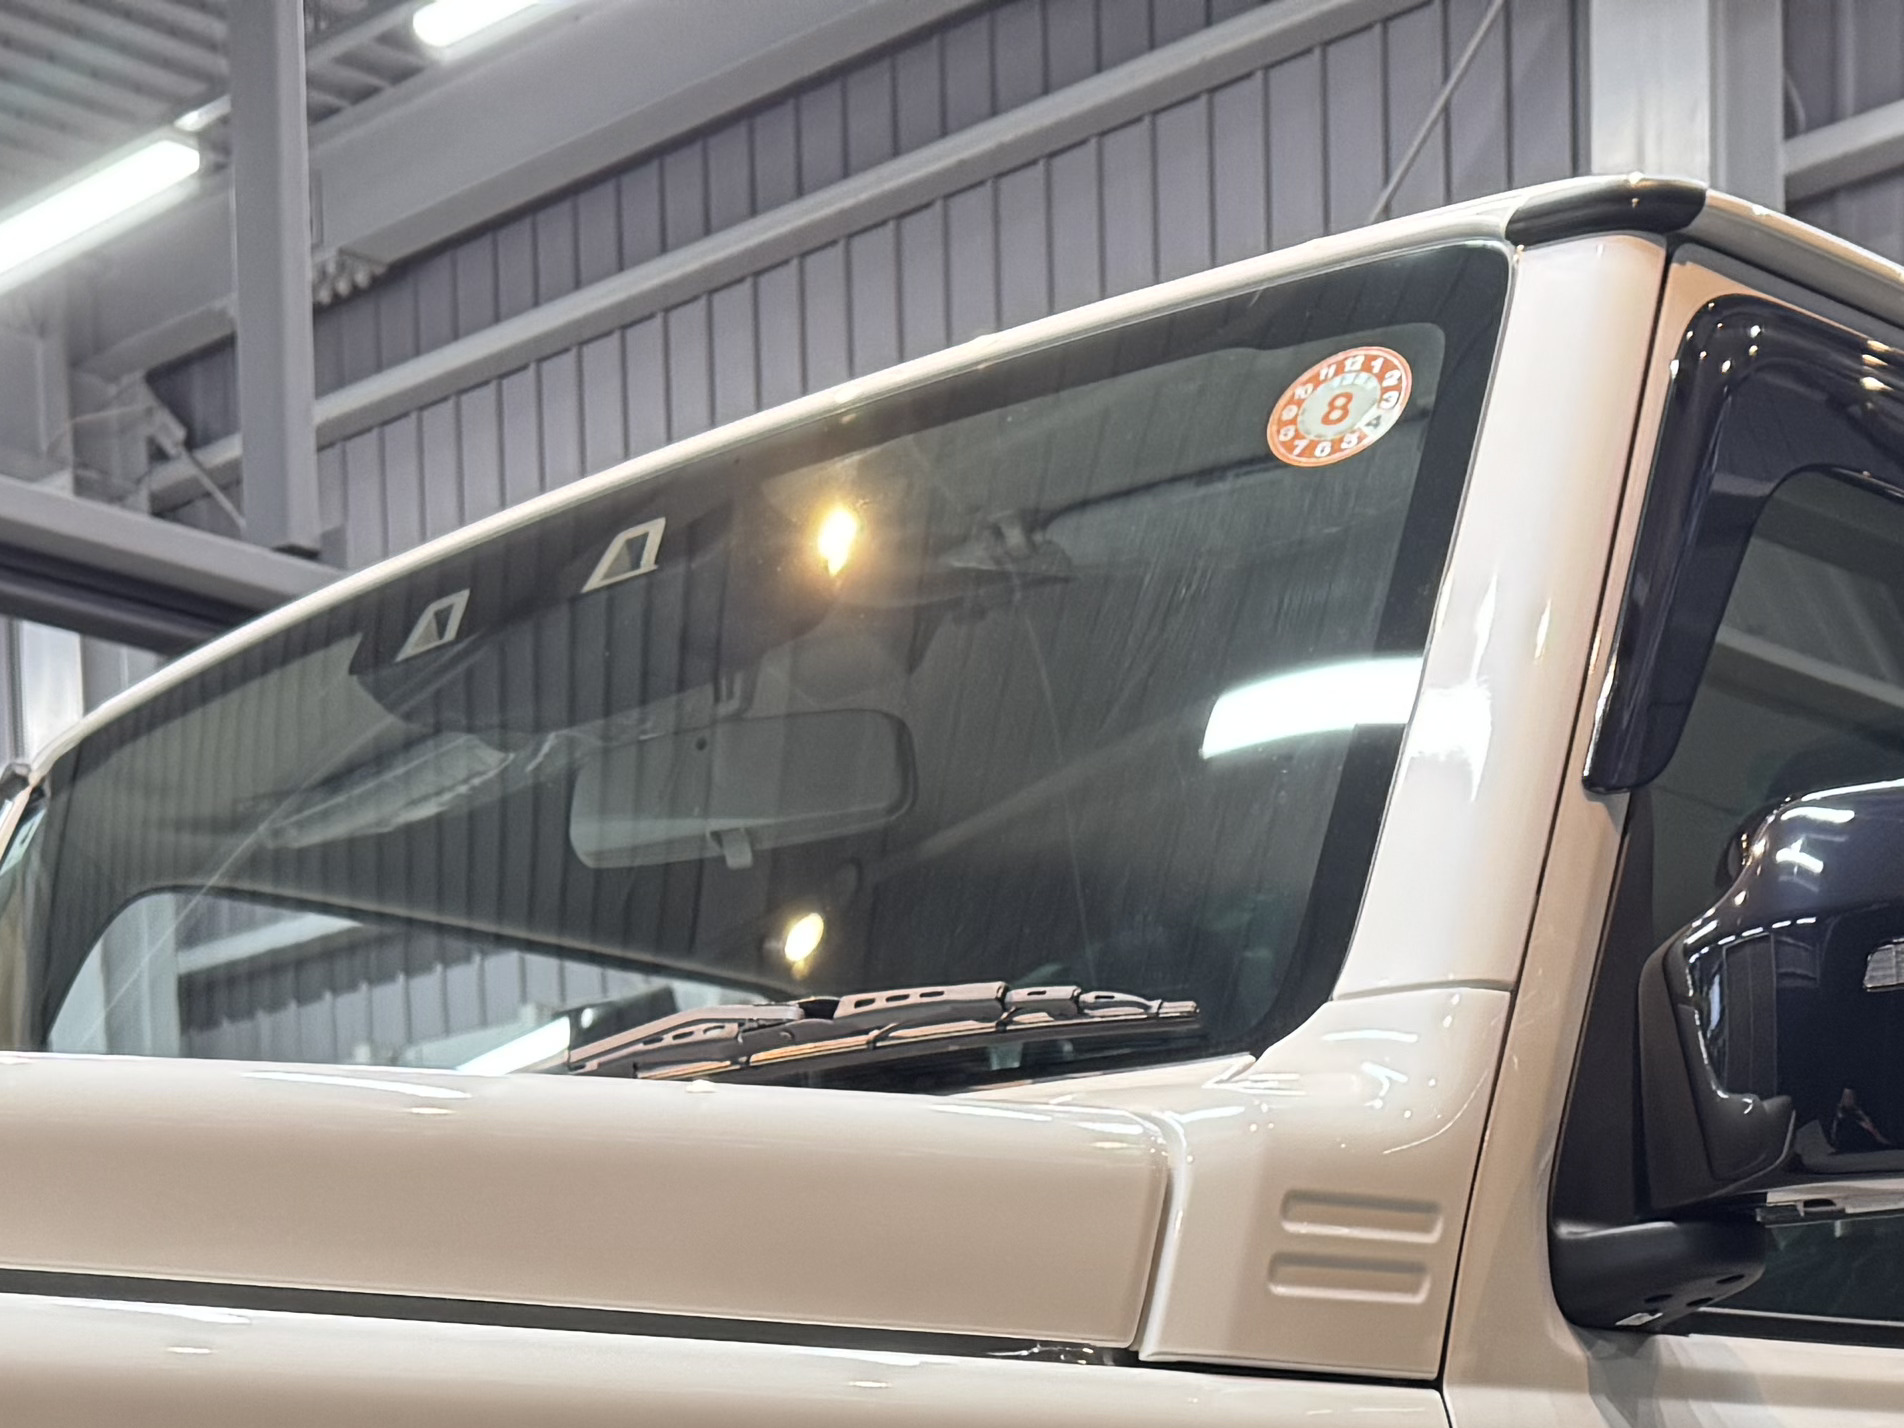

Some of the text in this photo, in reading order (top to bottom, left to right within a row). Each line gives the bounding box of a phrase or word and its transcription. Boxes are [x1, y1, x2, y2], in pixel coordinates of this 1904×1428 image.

[1370, 357, 1385, 374] 1
[1382, 369, 1401, 387] 2
[1320, 391, 1354, 426] 8
[1379, 390, 1400, 410] 3
[1365, 415, 1382, 430] 4
[1293, 439, 1310, 456] 7
[1340, 431, 1360, 449] 5
[1314, 441, 1332, 458] 6
